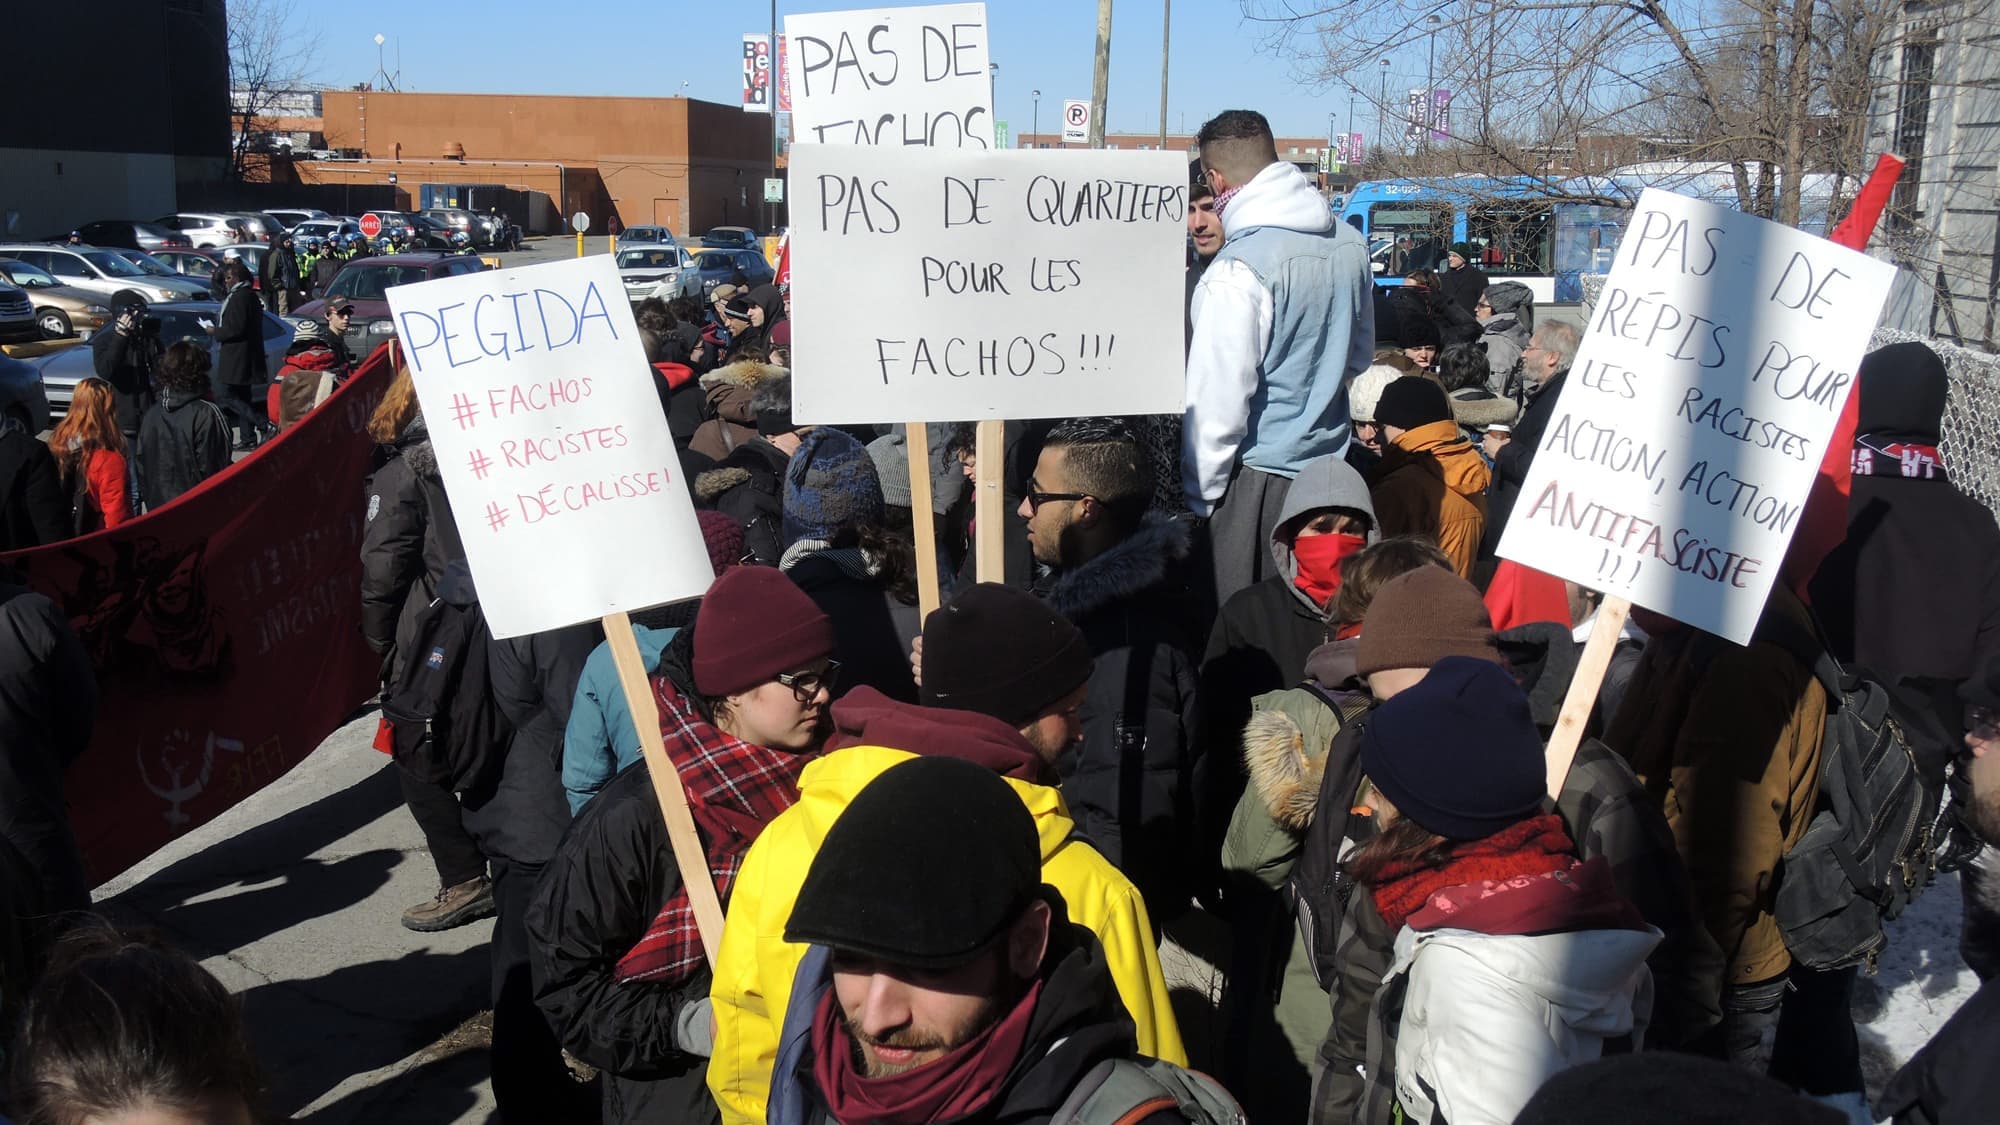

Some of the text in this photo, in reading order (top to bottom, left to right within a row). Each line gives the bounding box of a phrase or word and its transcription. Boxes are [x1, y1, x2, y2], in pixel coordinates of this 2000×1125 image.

[794, 24, 983, 97] PAS DE
[816, 173, 901, 235] PAS
[943, 175, 996, 229] DE
[1026, 174, 1186, 227] QUARTIERS
[921, 256, 1081, 298] POUR LES
[1630, 210, 1852, 319] PAS DE
[399, 281, 619, 372] PEGIDA
[1596, 287, 1850, 412] RÉPIS POUR
[1581, 359, 1812, 461] LES RACISTES
[1545, 413, 1800, 535] ACTION, ACTION
[1596, 547, 1643, 590] !!!
